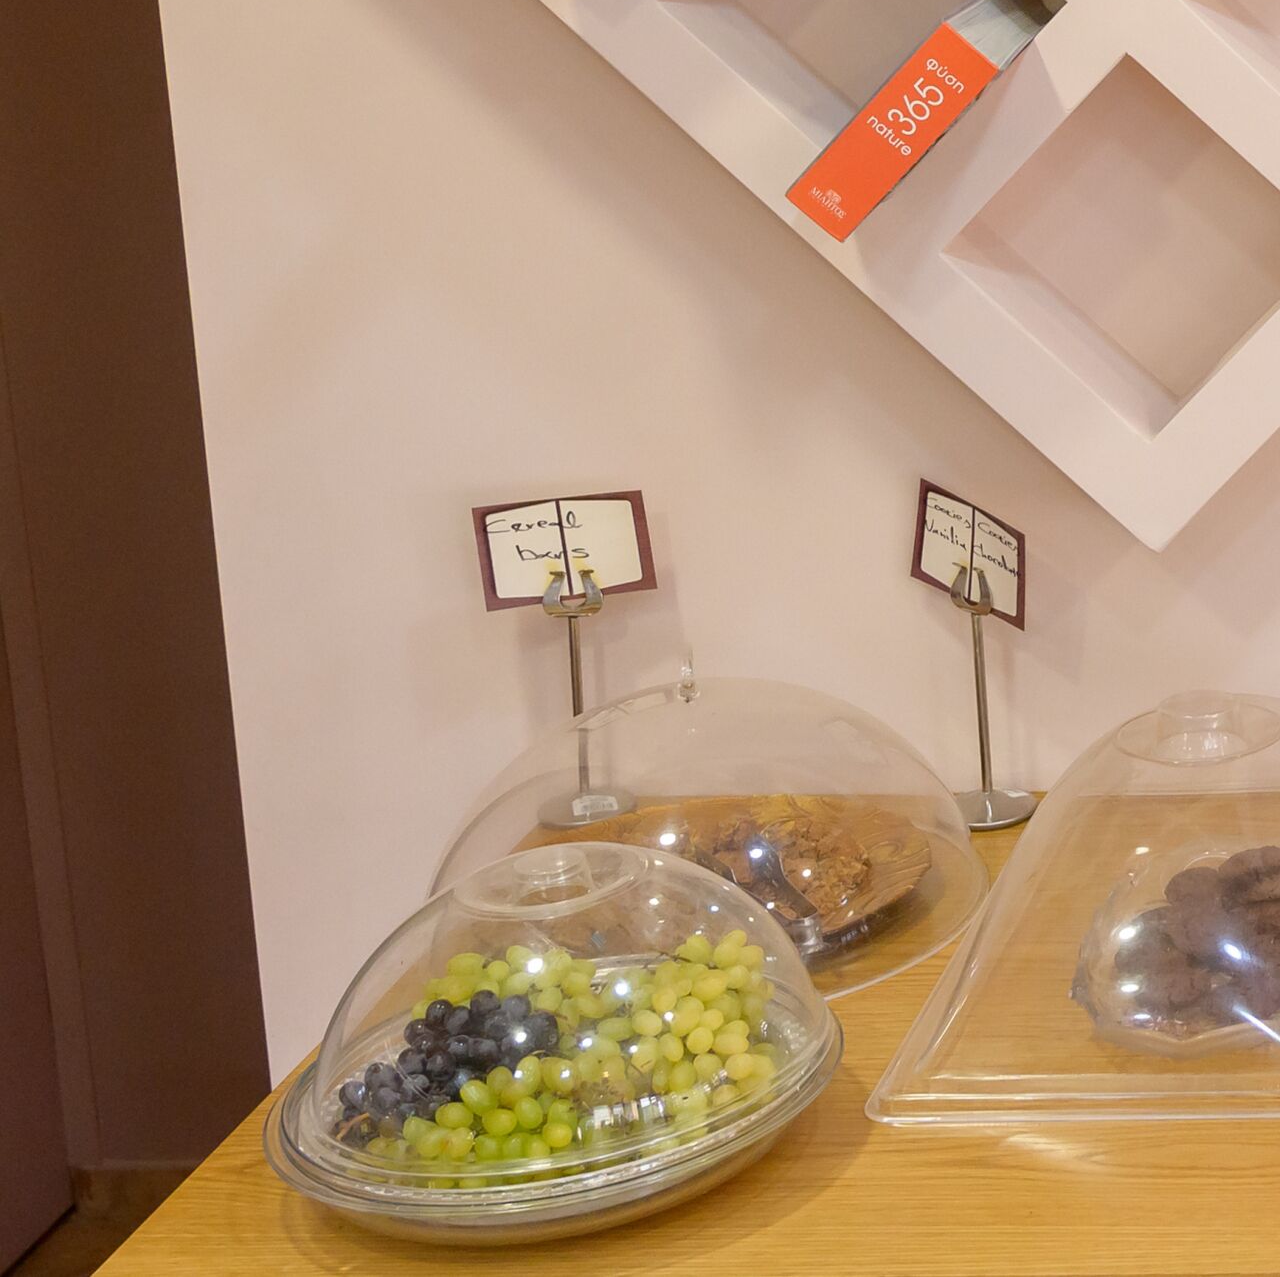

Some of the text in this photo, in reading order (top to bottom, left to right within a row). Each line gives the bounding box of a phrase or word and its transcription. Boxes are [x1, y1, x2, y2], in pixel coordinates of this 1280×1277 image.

[925, 58, 965, 94] φύση
[887, 77, 945, 136] 365
[866, 115, 912, 157] nature
